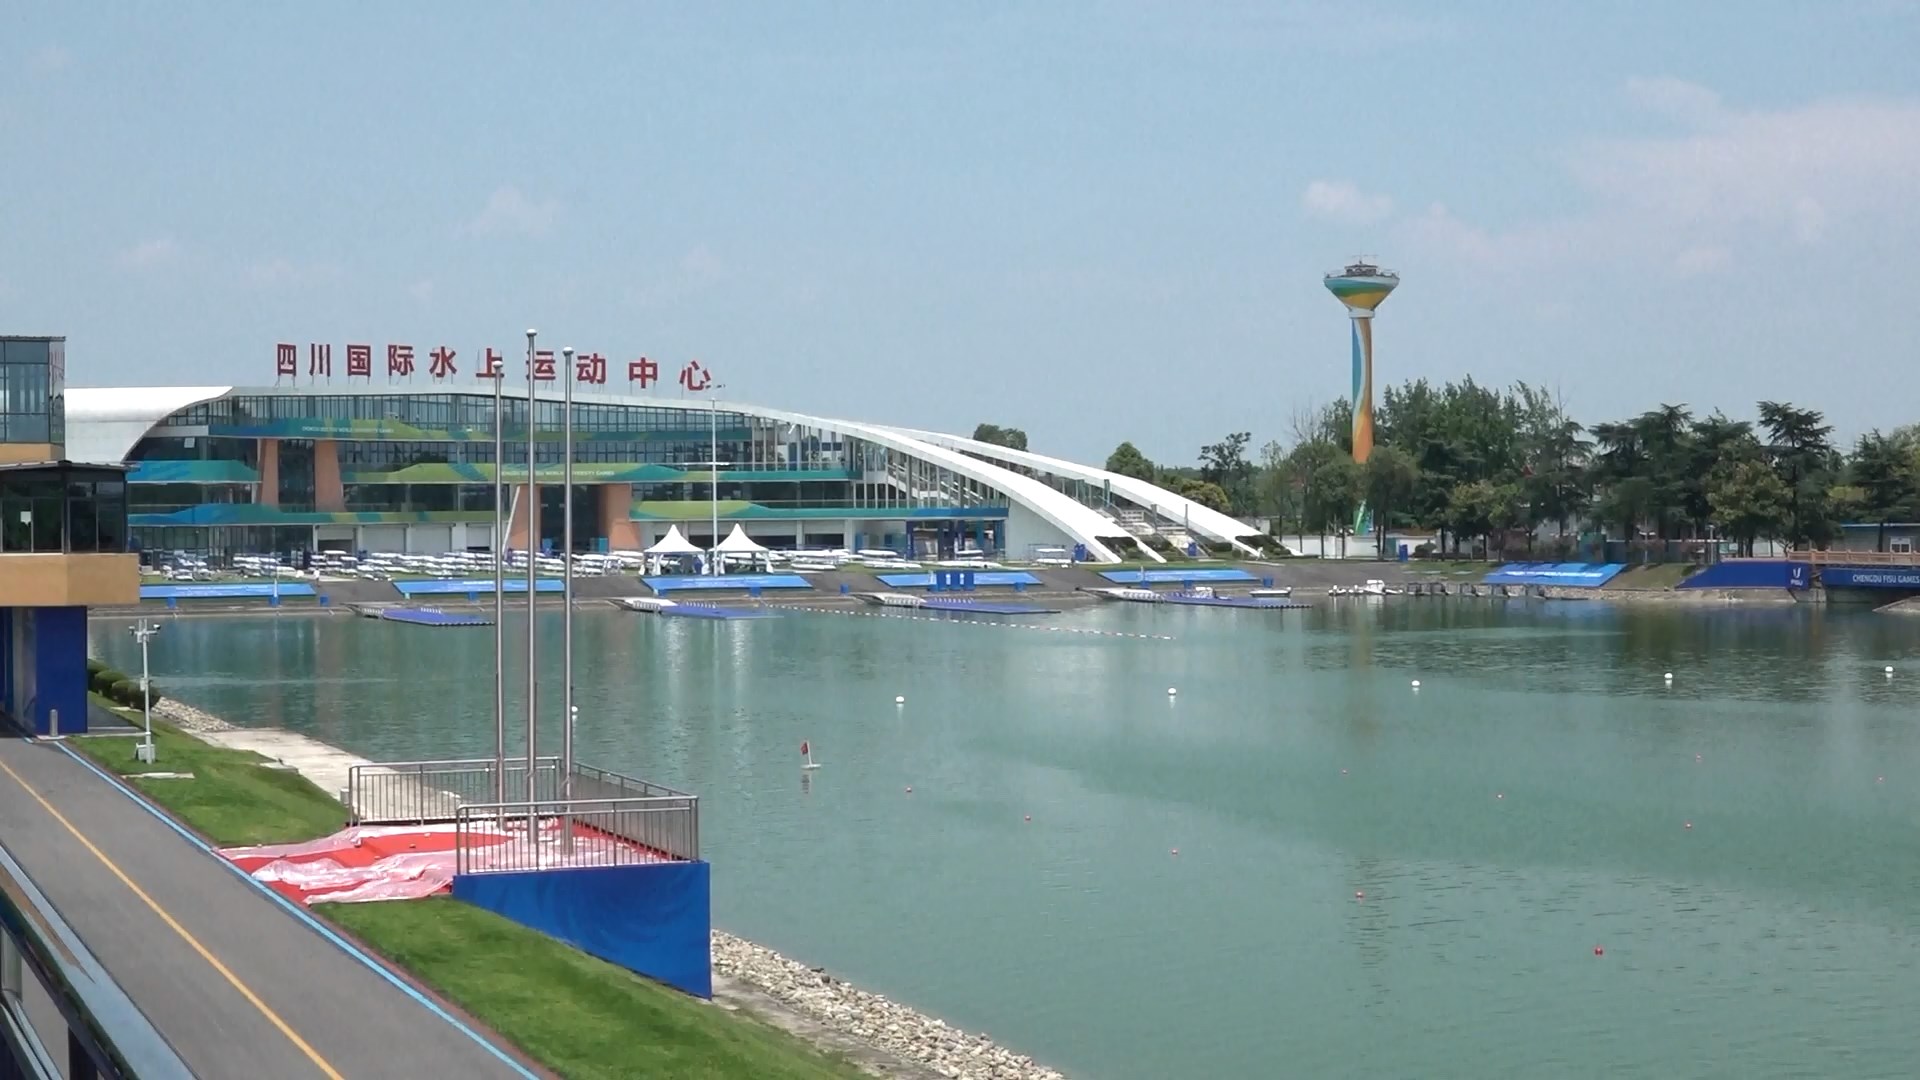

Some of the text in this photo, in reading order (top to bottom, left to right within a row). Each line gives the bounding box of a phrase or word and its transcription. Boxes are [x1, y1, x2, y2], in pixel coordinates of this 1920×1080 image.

[277, 343, 711, 391] 四川国际水上运动中心
[1852, 574, 1920, 584] CHENGDU FISU GAMES
